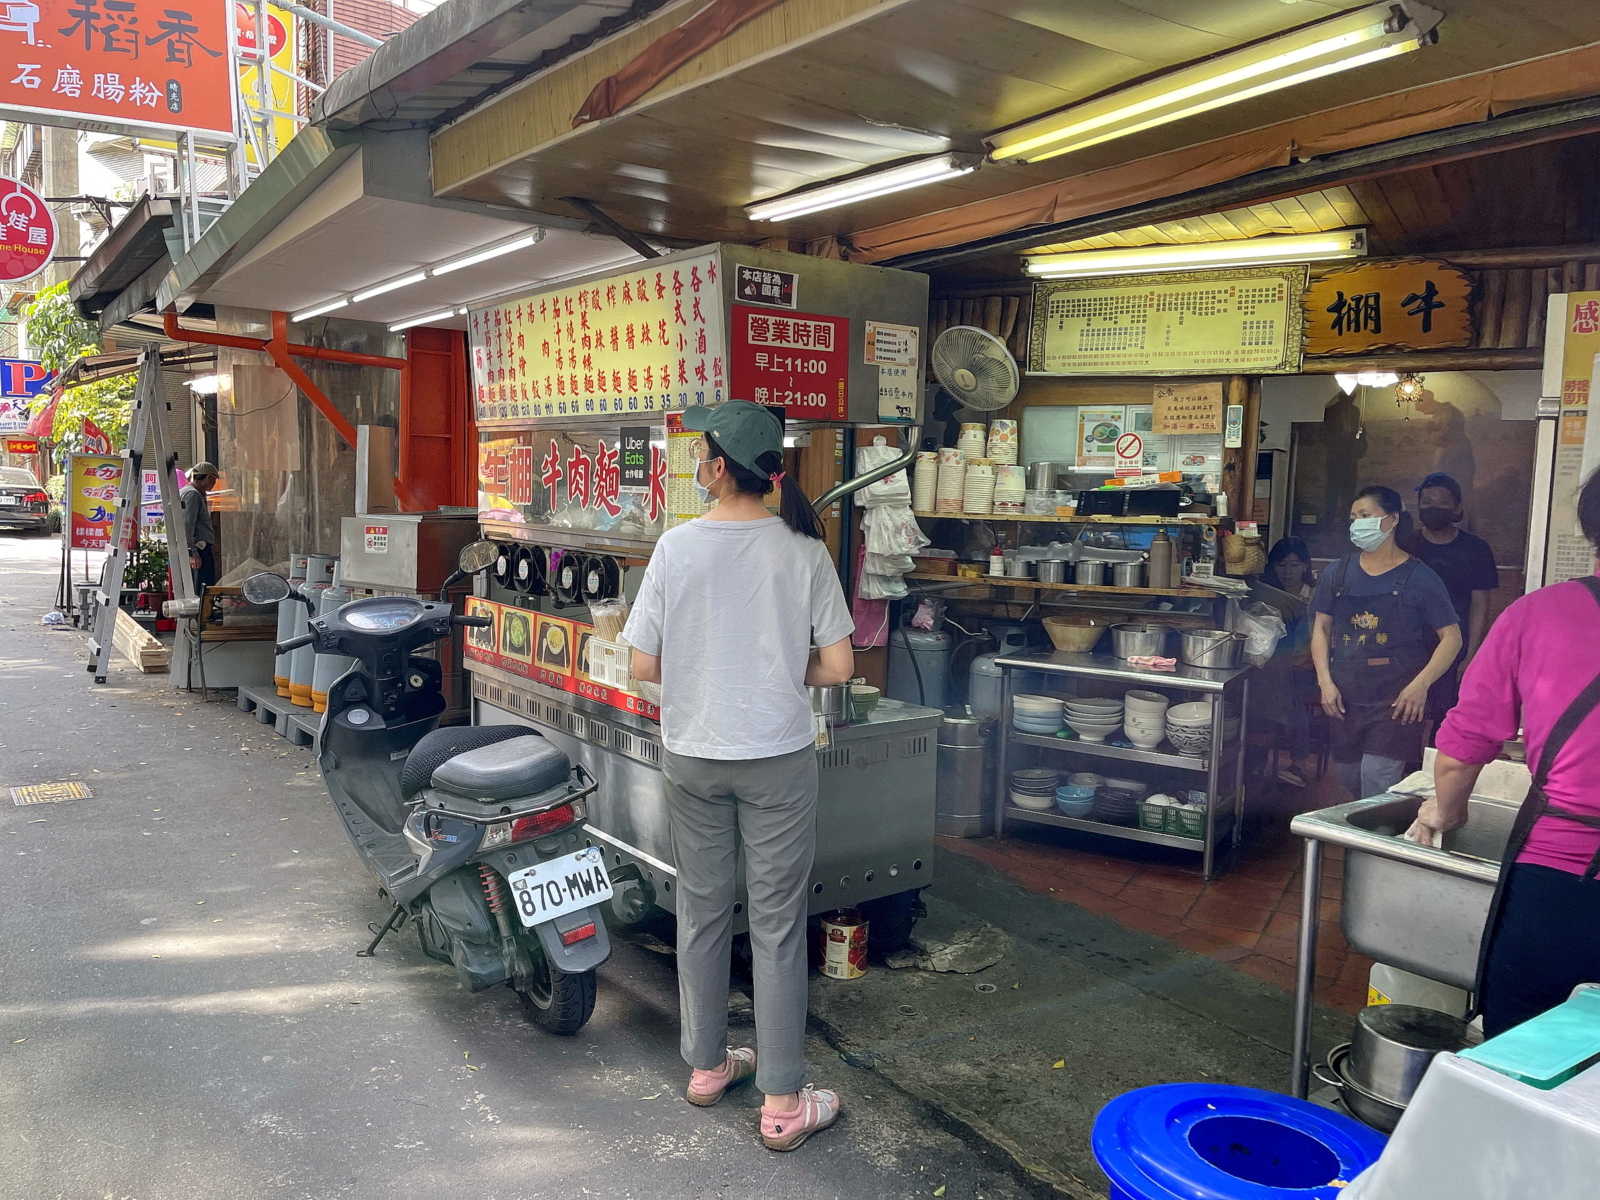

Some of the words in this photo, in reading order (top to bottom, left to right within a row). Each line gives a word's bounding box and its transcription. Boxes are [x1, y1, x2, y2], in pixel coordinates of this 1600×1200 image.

[10, 64, 164, 107] 石磨腸粉
[14, 244, 45, 255] House
[742, 269, 781, 285] 本店皆為
[762, 284, 781, 298] 國產
[671, 269, 689, 386] 各式小菜
[690, 265, 708, 387] 各式滷味
[1572, 300, 1600, 334] 感
[578, 289, 595, 394] 榨菜肉絲麵
[622, 280, 638, 393] 麻醬麵
[636, 276, 653, 390] 酸辣湯
[654, 272, 671, 390] 蛋花湯
[707, 260, 723, 378] 水餃
[715, 389, 721, 403] 6
[750, 316, 831, 349] 營業時間
[591, 287, 607, 393] 酸辣麵
[599, 398, 607, 411] 60
[755, 353, 827, 375] 早上11:00
[4, 362, 46, 396] P
[558, 402, 566, 414] 60
[585, 399, 594, 411] 60
[614, 398, 623, 411] 60
[628, 397, 638, 410] 60
[644, 396, 654, 409] 35
[661, 394, 671, 409] 35
[678, 393, 688, 408] 30
[695, 391, 705, 407] 30
[755, 387, 827, 407] 晚上21:00
[625, 436, 645, 450] Uber
[625, 451, 645, 465] Eats
[484, 446, 532, 506] 牛棚
[541, 438, 622, 518] 牛肉麵
[519, 865, 609, 917] 870-MWA
